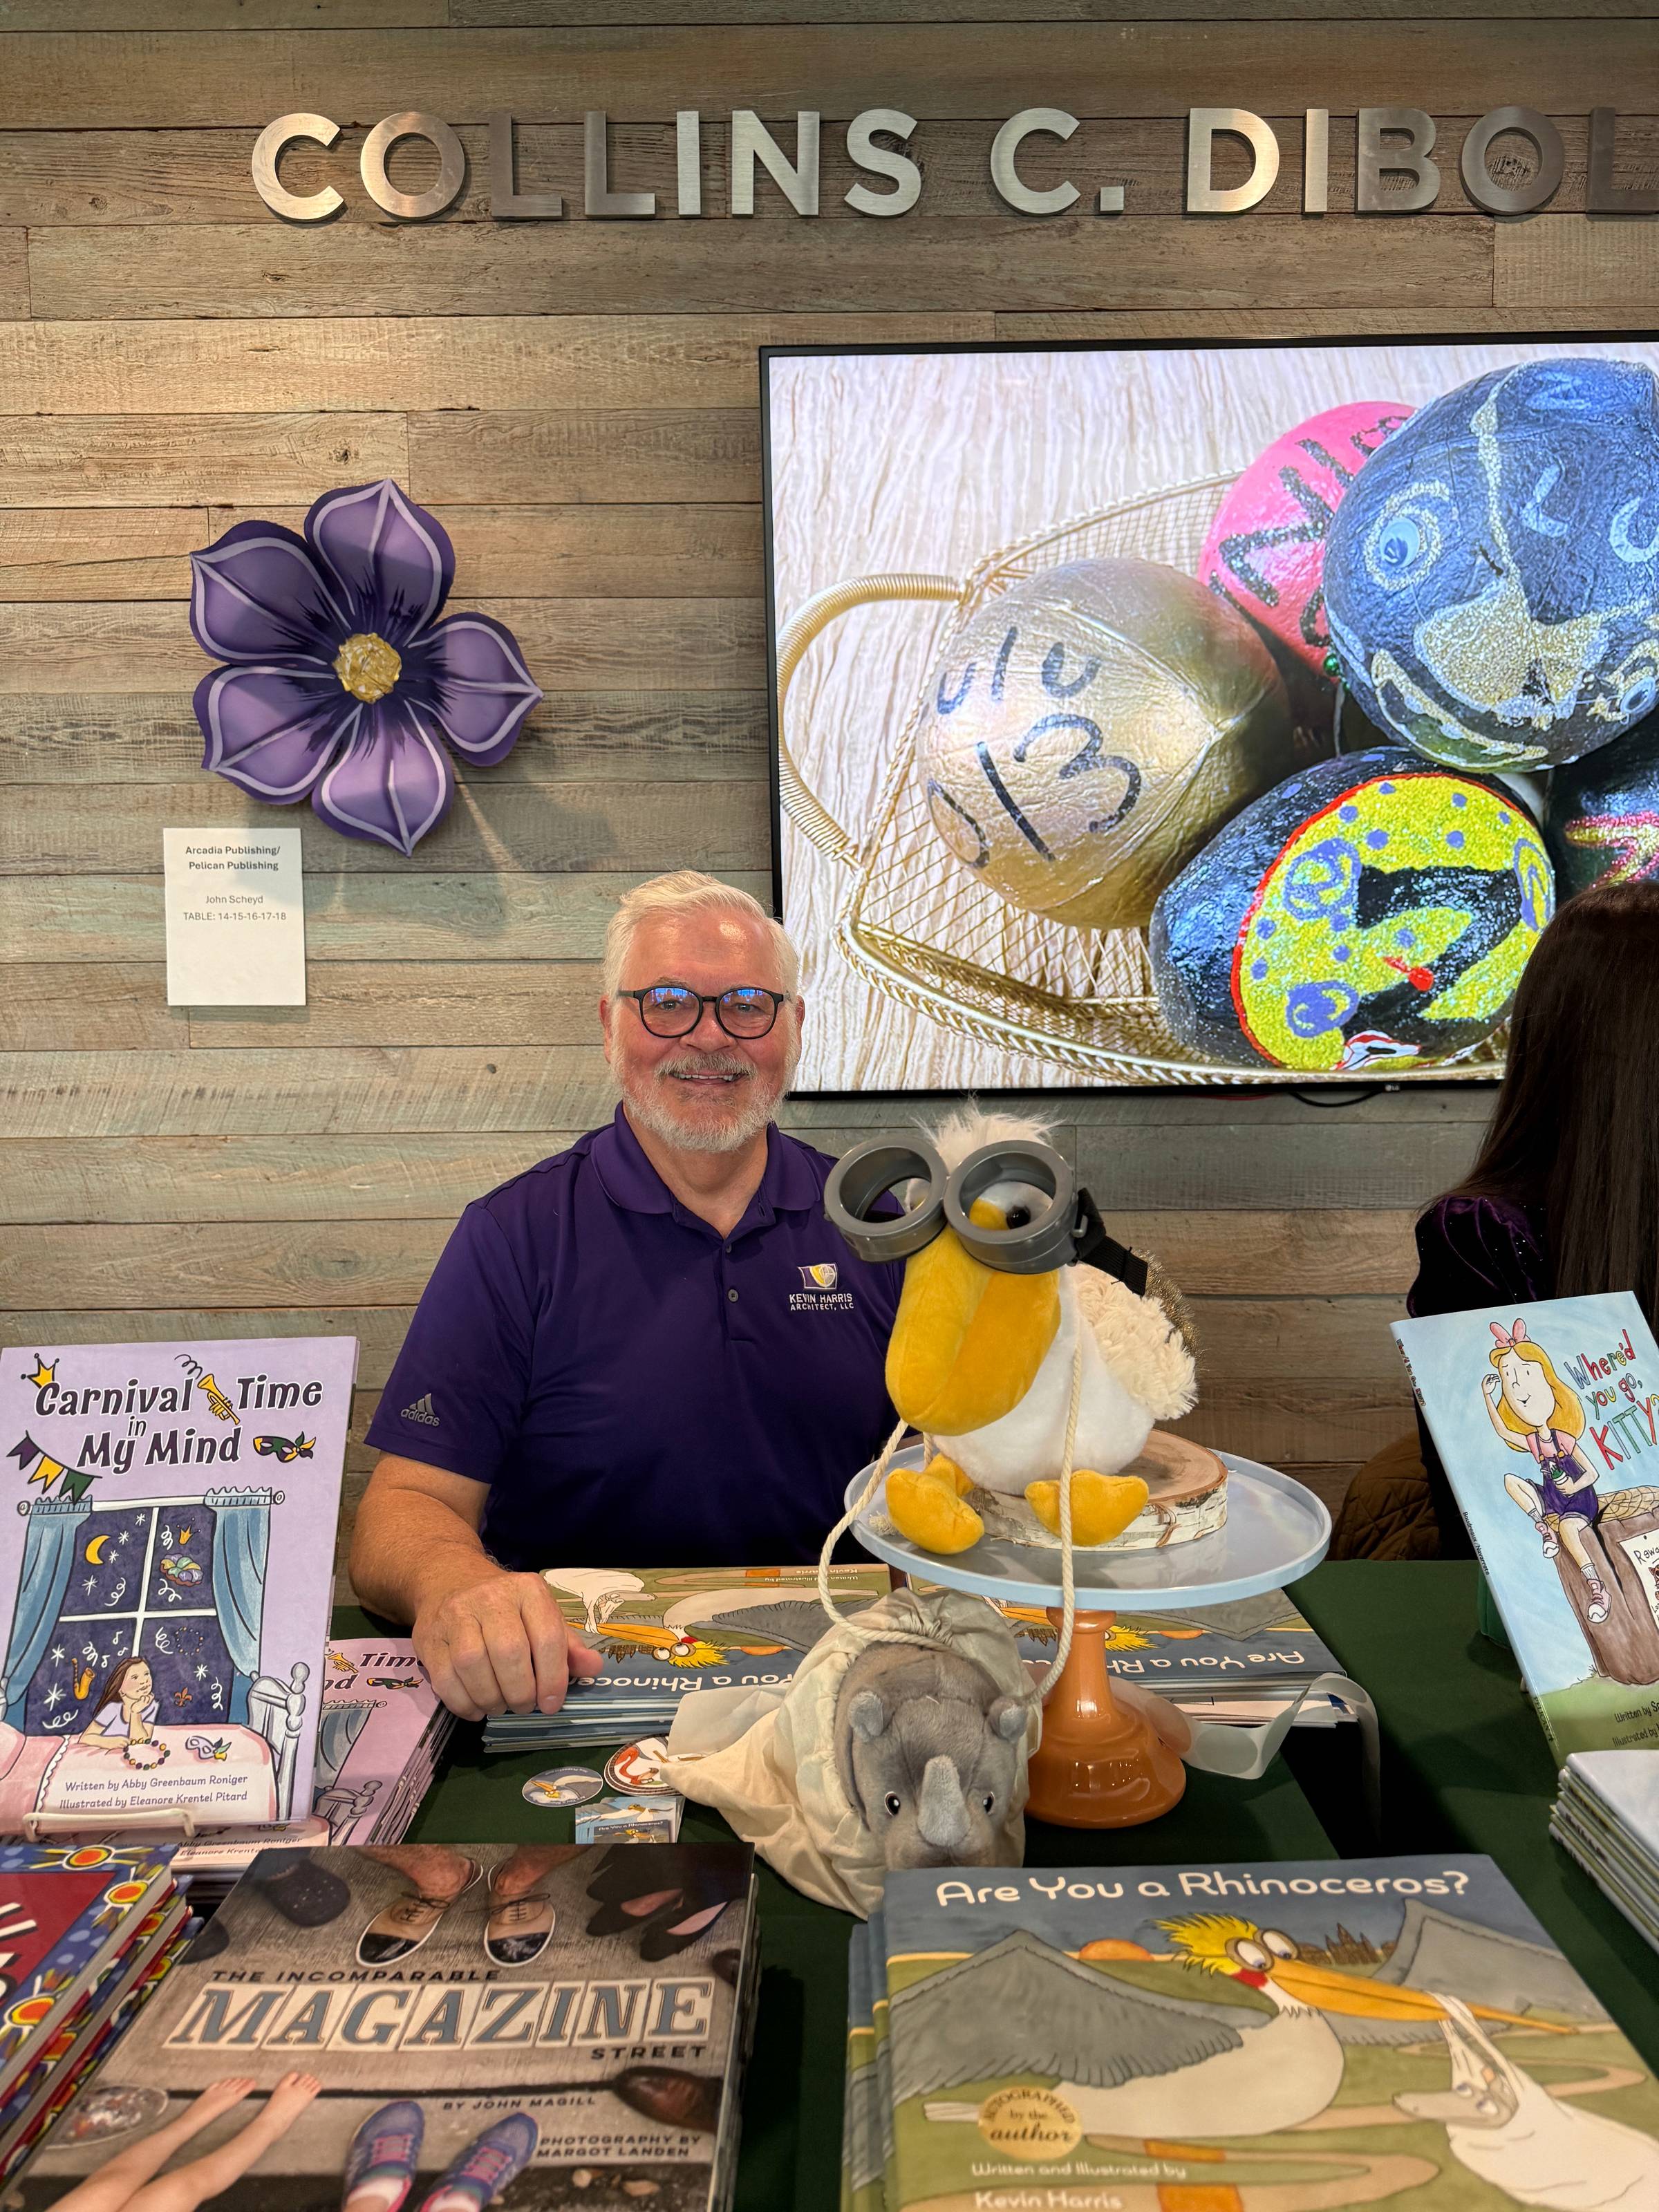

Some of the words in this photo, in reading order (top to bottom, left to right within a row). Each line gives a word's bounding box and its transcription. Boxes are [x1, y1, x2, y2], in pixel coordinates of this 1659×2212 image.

[252, 109, 922, 220] COLLINS
[990, 106, 1125, 215] C.
[1185, 106, 1659, 215] DIBOL
[185, 846, 223, 855] Arcadia
[225, 845, 281, 856] Publishing/
[189, 861, 225, 870] Pelican
[227, 861, 279, 871] Publishing
[206, 895, 227, 904] John
[229, 895, 263, 906] Scheyd
[183, 912, 215, 921] TABLE:
[218, 912, 286, 921] 14-15-16-17-18
[789, 1293, 816, 1303] KEVIN
[820, 1293, 853, 1303] HARRIS
[1564, 1329, 1636, 1389] Where'd
[35, 1378, 194, 1417] Carnival
[237, 1374, 324, 1410] Time
[401, 1409, 440, 1427] adidas
[128, 1415, 147, 1437] in
[76, 1432, 136, 1475] My
[144, 1426, 243, 1465] Mind
[1150, 1658, 1172, 1668] a
[1181, 1656, 1246, 1670] You
[1247, 1651, 1306, 1665] Are
[713, 1676, 732, 1685] a
[1614, 1709, 1642, 1723] Written
[1641, 1706, 1652, 1717] by
[1648, 1727, 1658, 1738] by
[66, 1781, 104, 1792] Written
[107, 1780, 120, 1792] by
[122, 1779, 147, 1790] Abby
[150, 1777, 206, 1788] Greenbaum
[209, 1774, 248, 1785] Roniger
[59, 1797, 113, 1809] Illustrated
[115, 1797, 127, 1808] by
[130, 1795, 174, 1806] Eleanore
[176, 1792, 213, 1803] Krentel
[216, 1790, 248, 1801] Pitard
[937, 1881, 1021, 1907] Are
[1029, 1875, 1124, 1900] You
[1138, 1881, 1170, 1897] a
[1178, 1870, 1470, 1897] Rhinoceros?
[212, 1970, 265, 1983] THE
[276, 1969, 501, 1983] INCOMPARABLE
[172, 1980, 712, 2045] MAGAZINE
[590, 2045, 706, 2060] STREET
[442, 2101, 465, 2110] BY
[473, 2099, 521, 2110] JOHN
[529, 2097, 597, 2108] MAGILL
[1009, 2108, 1025, 2120] by
[1029, 2106, 1049, 2119] the
[989, 2121, 1071, 2142] author
[539, 2135, 673, 2146] PHOTOGRAPHY
[678, 2135, 702, 2144] BY
[536, 2147, 613, 2158] MARGOT
[619, 2146, 689, 2157] LANDEN
[971, 2162, 1029, 2177] Written
[1038, 2162, 1071, 2176] and
[1076, 2162, 1159, 2177] Illustrated
[1163, 2162, 1187, 2180] by
[975, 2191, 1042, 2209] Kevin
[1047, 2191, 1123, 2211] Harris
